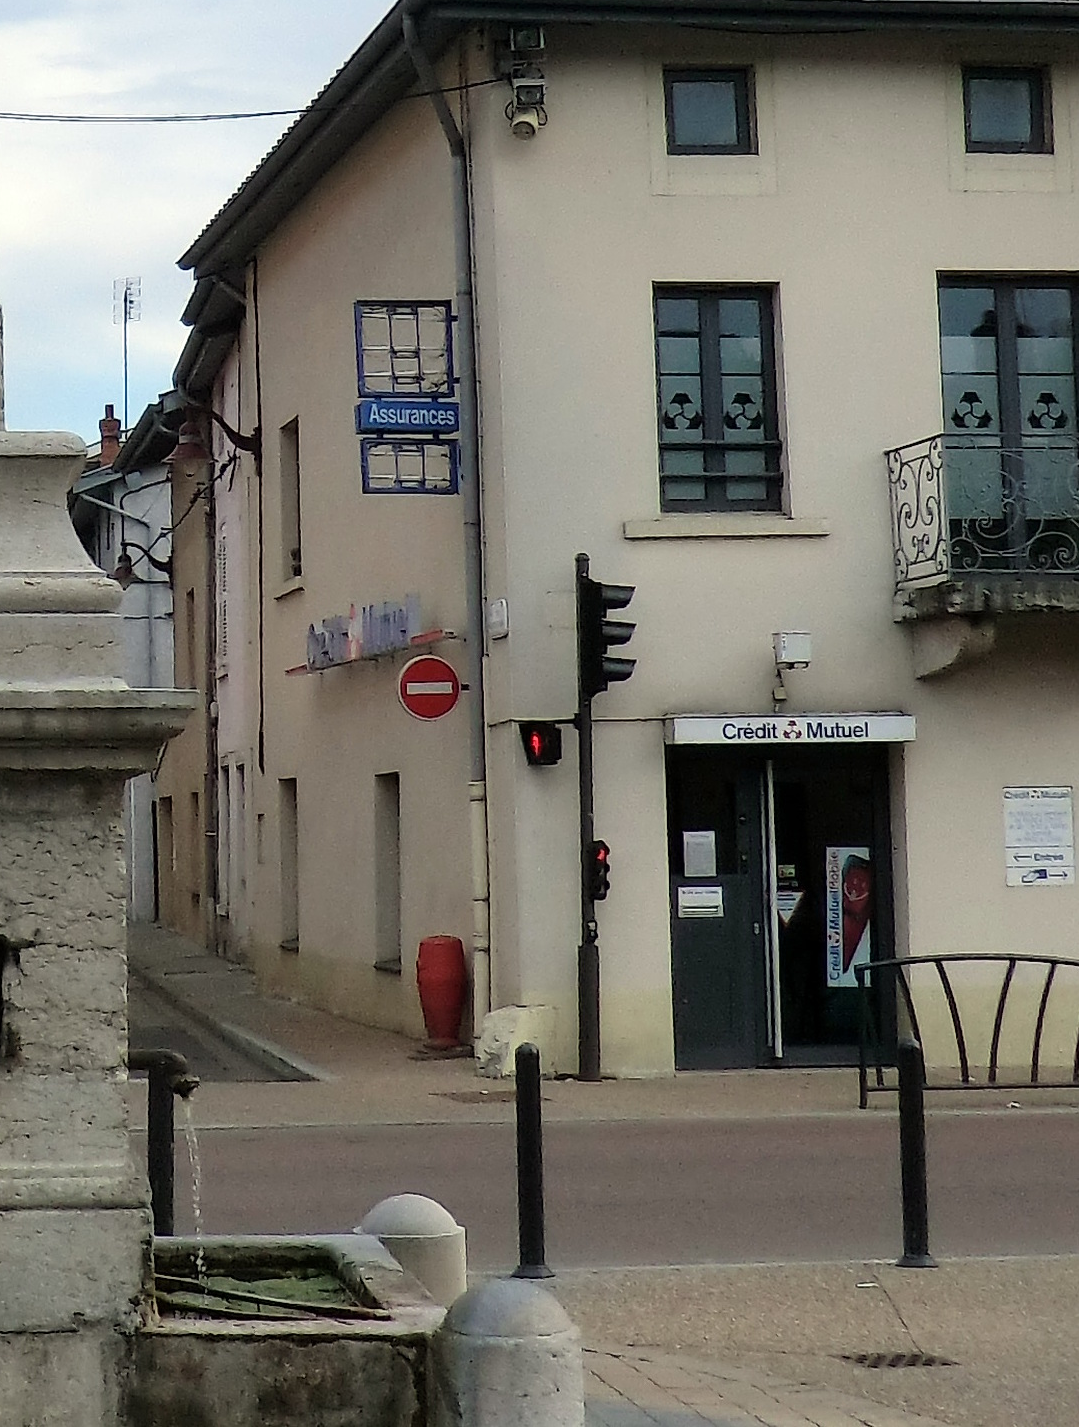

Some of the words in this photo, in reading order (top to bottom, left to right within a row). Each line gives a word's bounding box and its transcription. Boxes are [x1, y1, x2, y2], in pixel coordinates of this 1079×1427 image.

[369, 403, 455, 425] Assurances
[722, 722, 778, 739] Crédit
[807, 722, 869, 739] Mutuel
